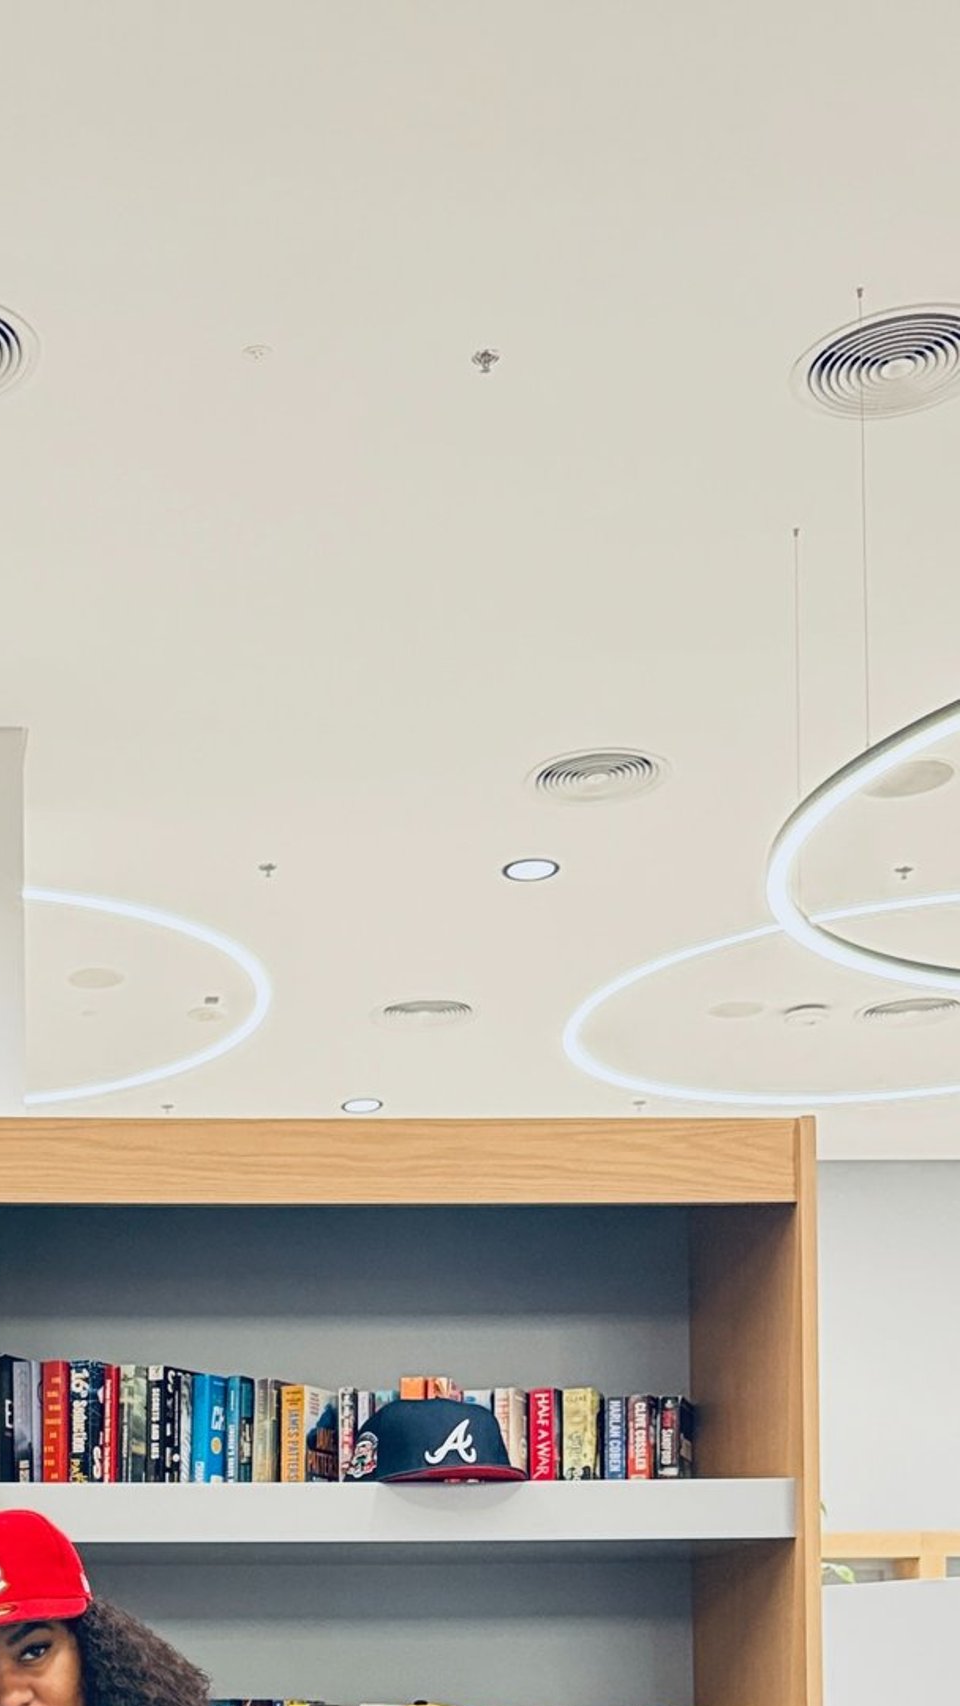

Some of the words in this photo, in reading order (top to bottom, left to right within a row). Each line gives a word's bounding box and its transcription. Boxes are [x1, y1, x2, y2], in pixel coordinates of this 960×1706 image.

[534, 1392, 550, 1426] HALF
[609, 1400, 622, 1438] HARLAN
[634, 1402, 646, 1428] CLIVE
[150, 1424, 160, 1440] AND
[424, 1418, 477, 1464] A
[537, 1428, 550, 1440] A
[634, 1429, 646, 1470] CUSSLER
[287, 1440, 299, 1483] PATTERS
[532, 1441, 551, 1479] WAR
[609, 1440, 622, 1472] COBEN
